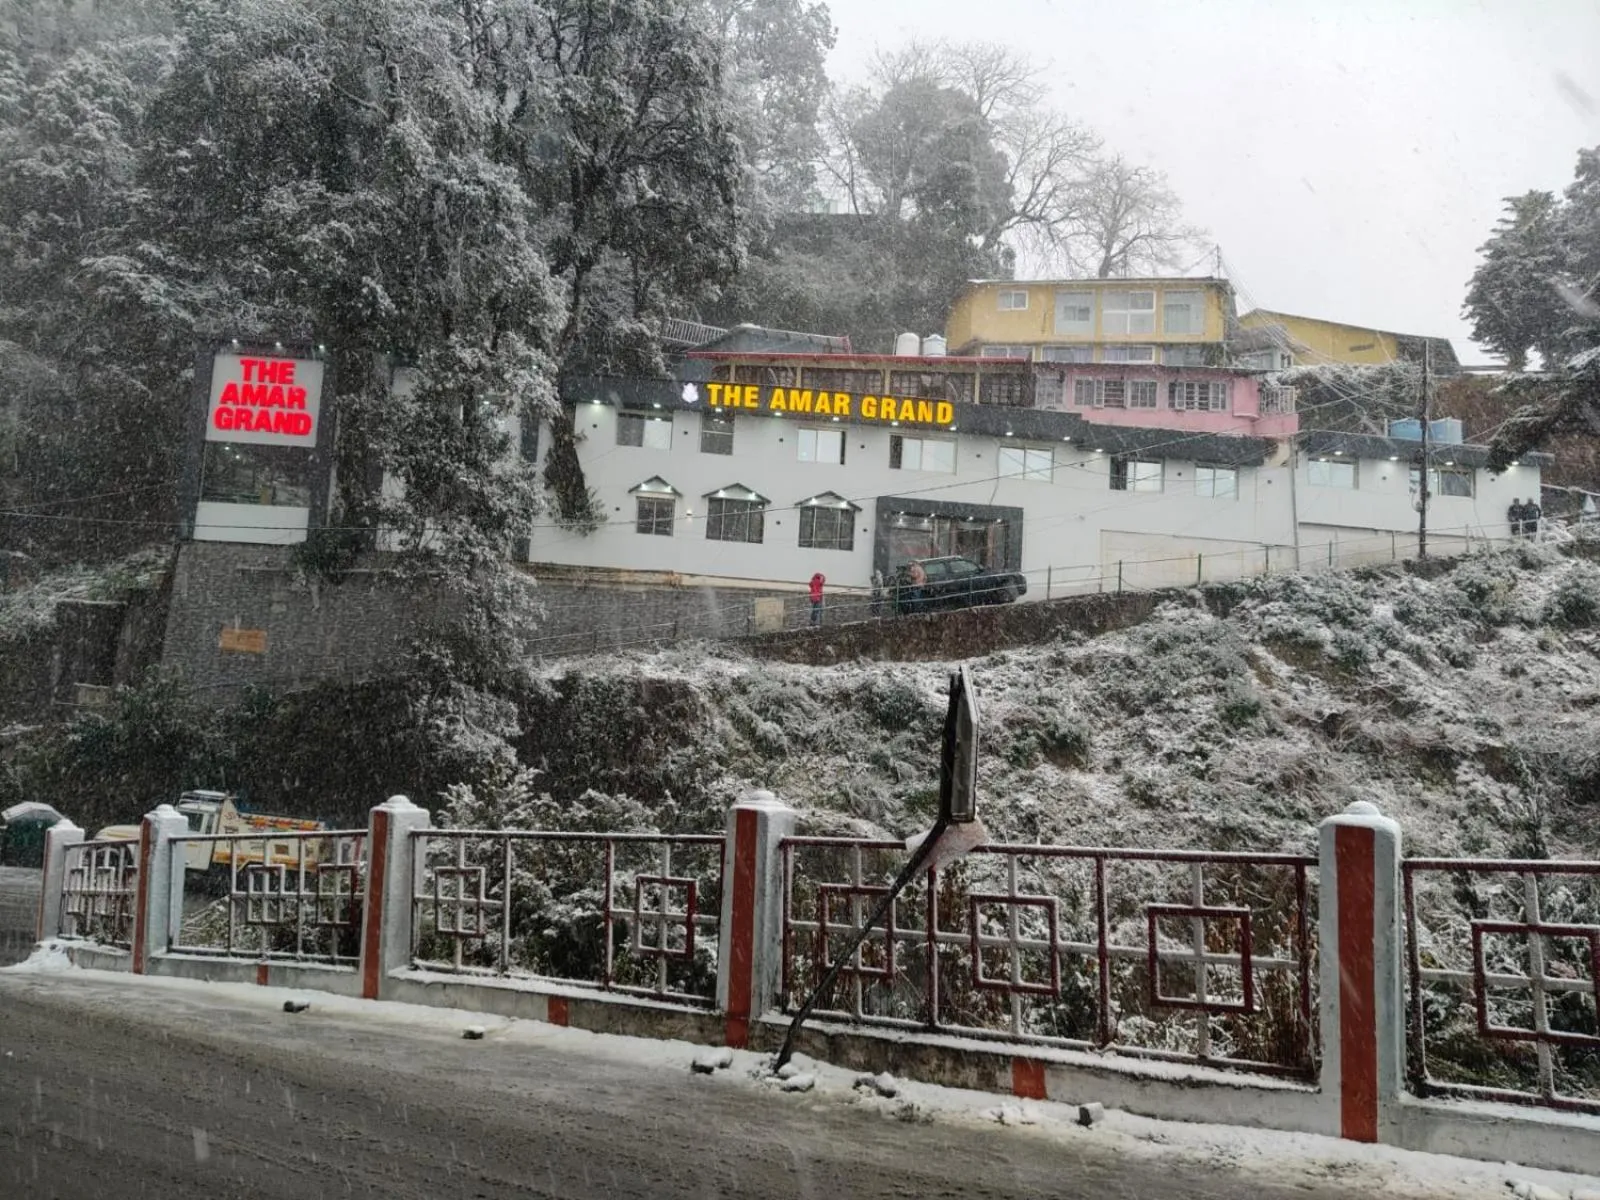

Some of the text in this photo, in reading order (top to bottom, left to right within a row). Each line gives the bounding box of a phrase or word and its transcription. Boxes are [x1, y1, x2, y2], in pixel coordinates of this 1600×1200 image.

[240, 358, 295, 385] THE
[220, 382, 307, 410] AMAR
[706, 383, 954, 424] THE AMAR GRAND
[214, 406, 312, 435] GRAND
